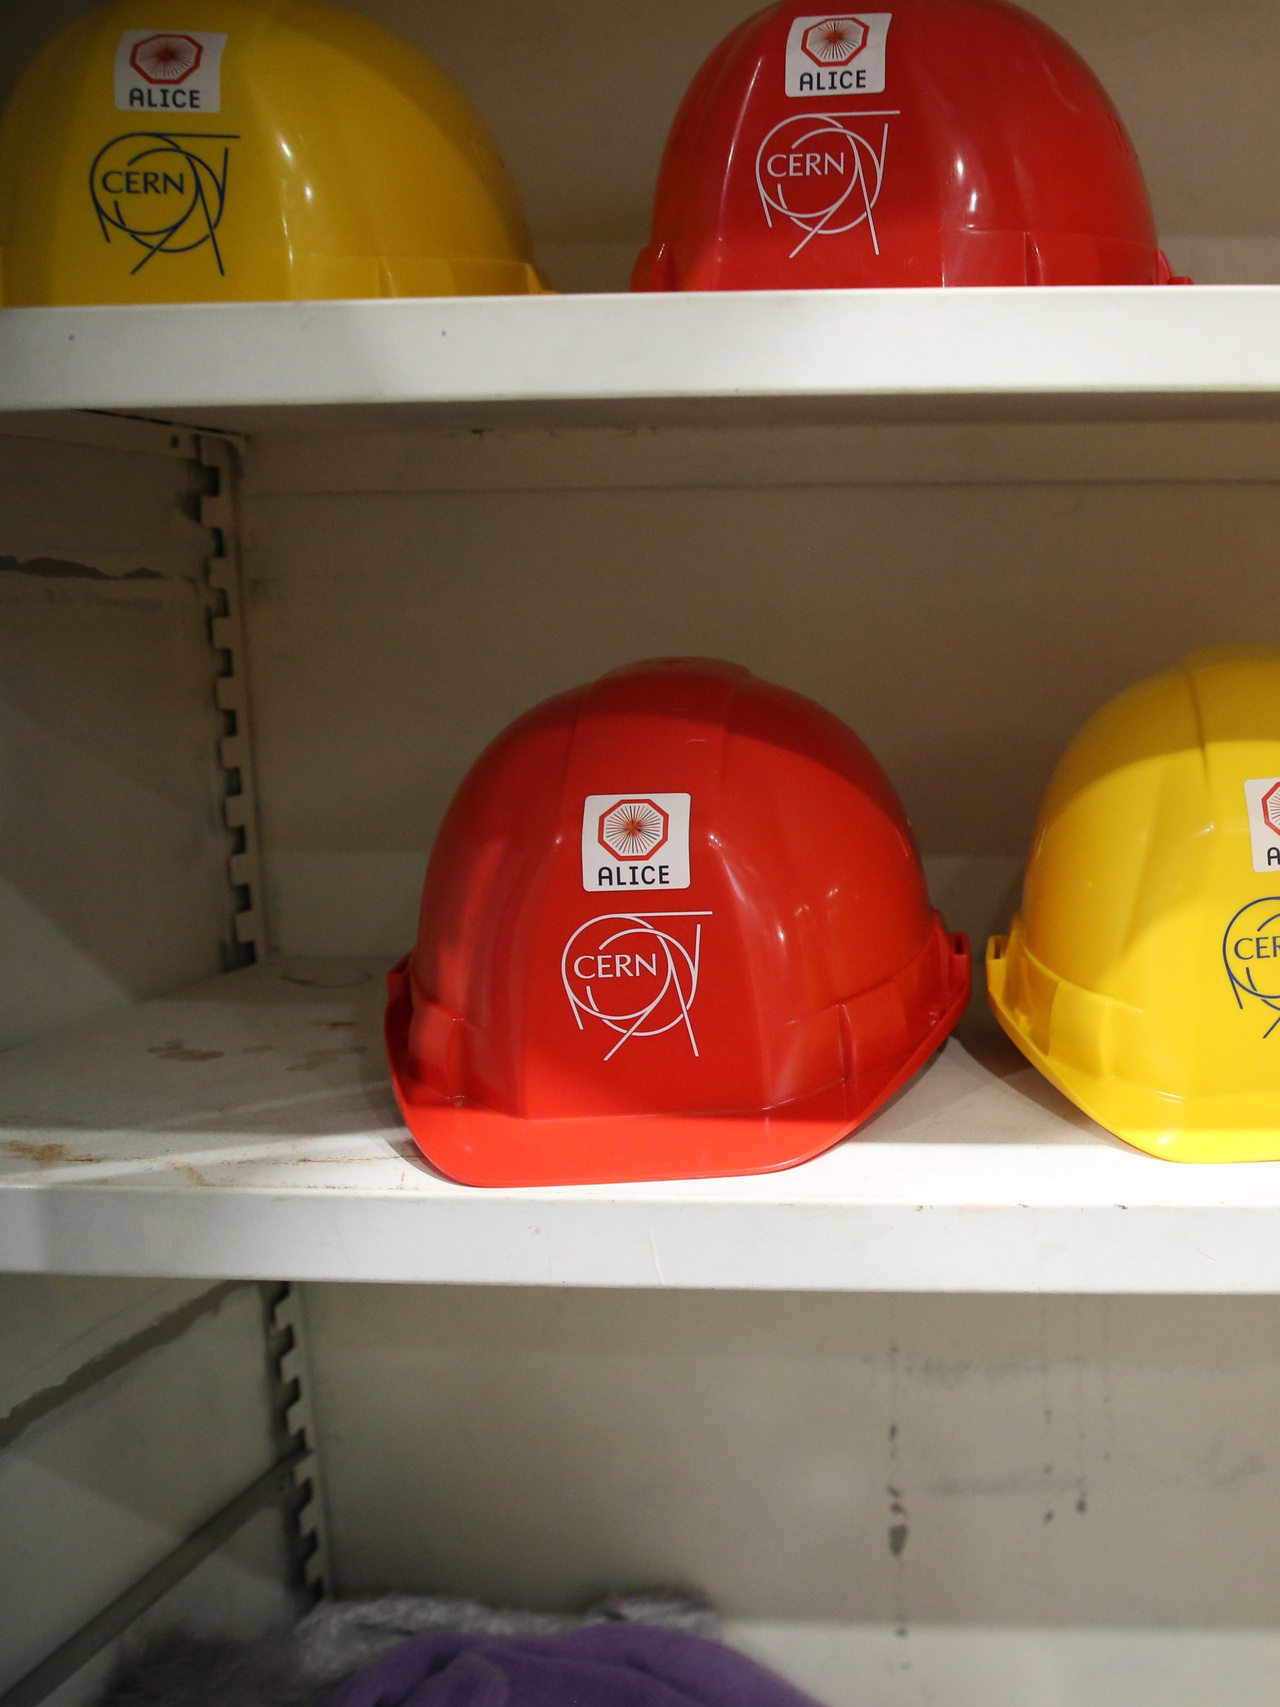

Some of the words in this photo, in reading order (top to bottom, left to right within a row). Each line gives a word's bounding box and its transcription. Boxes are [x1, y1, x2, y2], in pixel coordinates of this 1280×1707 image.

[800, 70, 866, 91] ALICE
[129, 88, 200, 108] ALICE
[767, 152, 845, 177] CERN
[102, 170, 185, 194] CERN
[598, 865, 670, 886] ALICE
[573, 953, 657, 978] CERN
